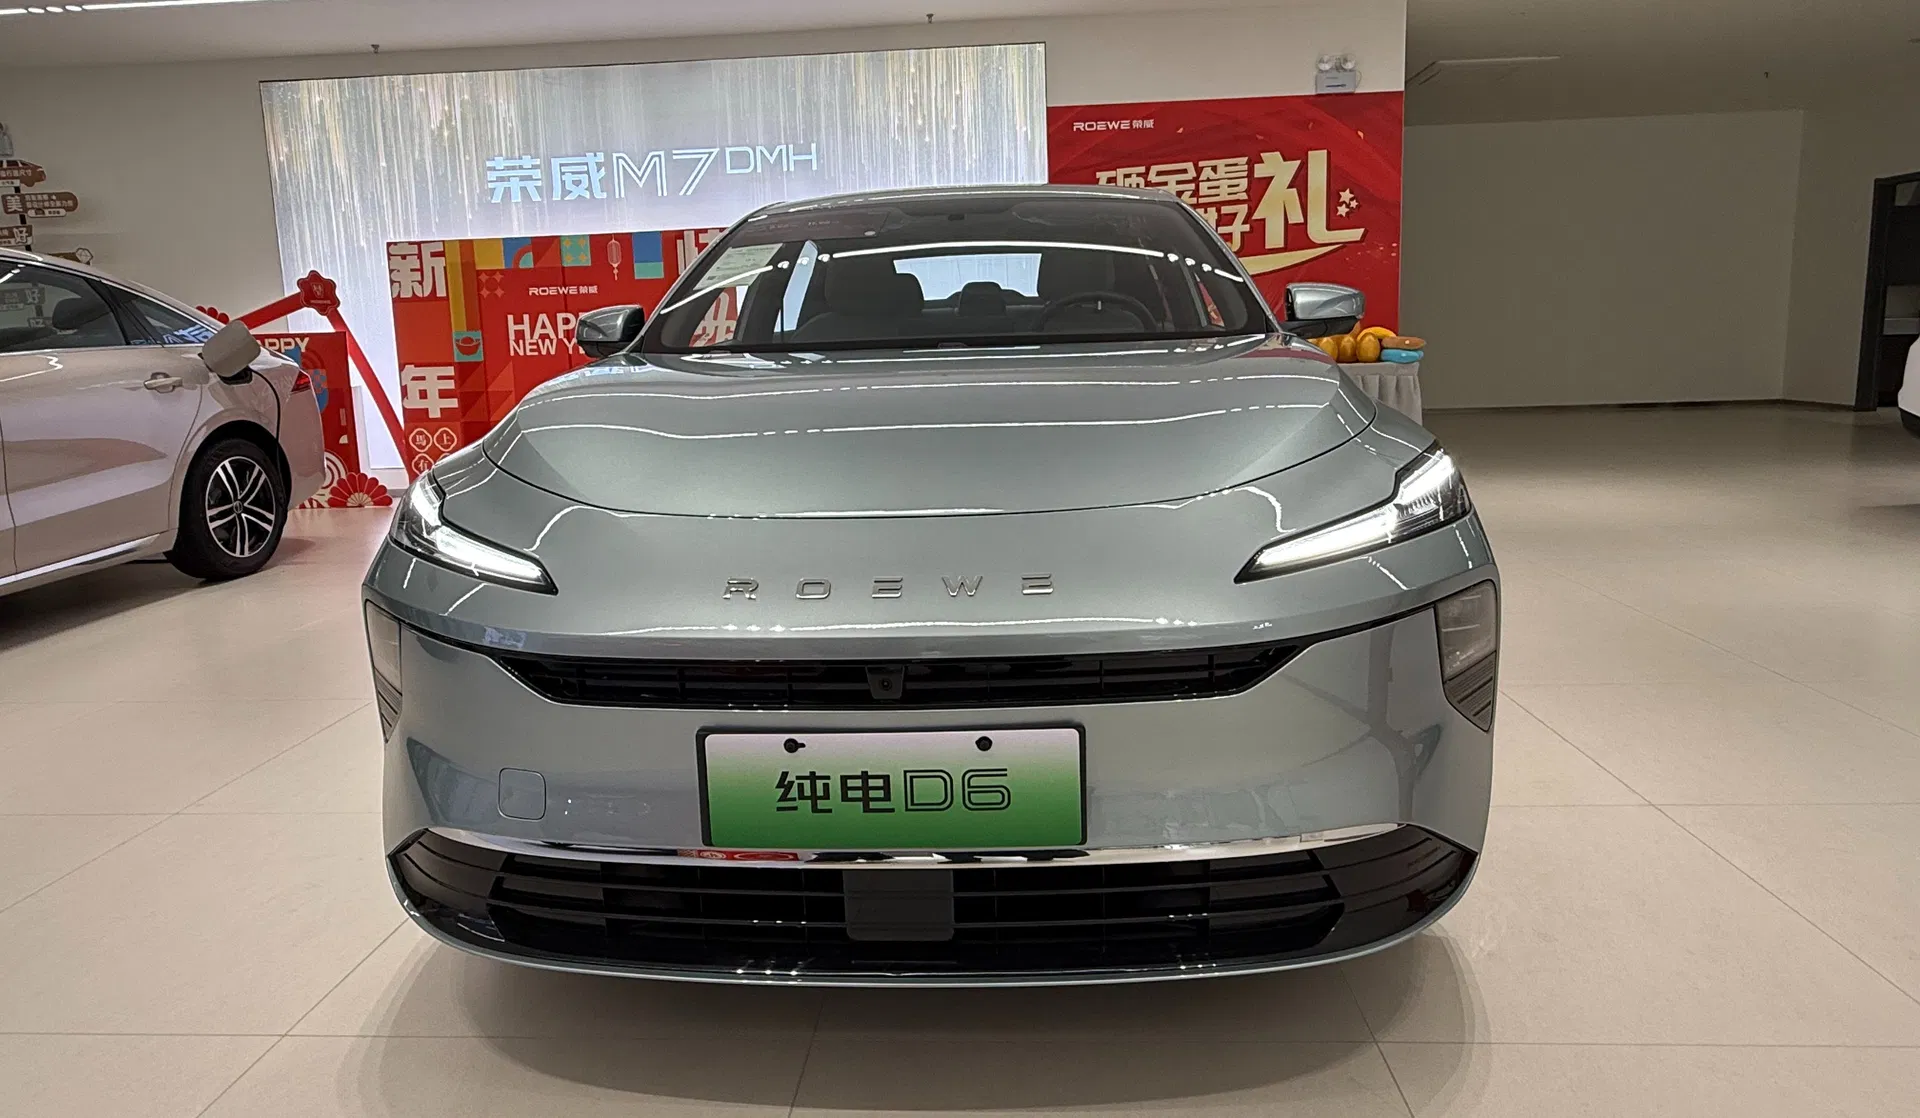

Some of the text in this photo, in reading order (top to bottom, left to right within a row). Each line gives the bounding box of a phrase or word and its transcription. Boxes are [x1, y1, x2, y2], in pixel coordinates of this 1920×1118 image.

[1073, 120, 1130, 132] ROEWE
[725, 142, 818, 174] DMH
[1252, 149, 1366, 250] 礼
[388, 241, 447, 299] 新
[528, 286, 578, 296] ROEWE
[507, 311, 588, 341] HAP
[256, 336, 310, 353] PPY
[509, 337, 558, 356] NEW
[401, 364, 460, 419] 年
[722, 573, 1055, 600] ROEWE
[775, 767, 1012, 814] 纯电D6
